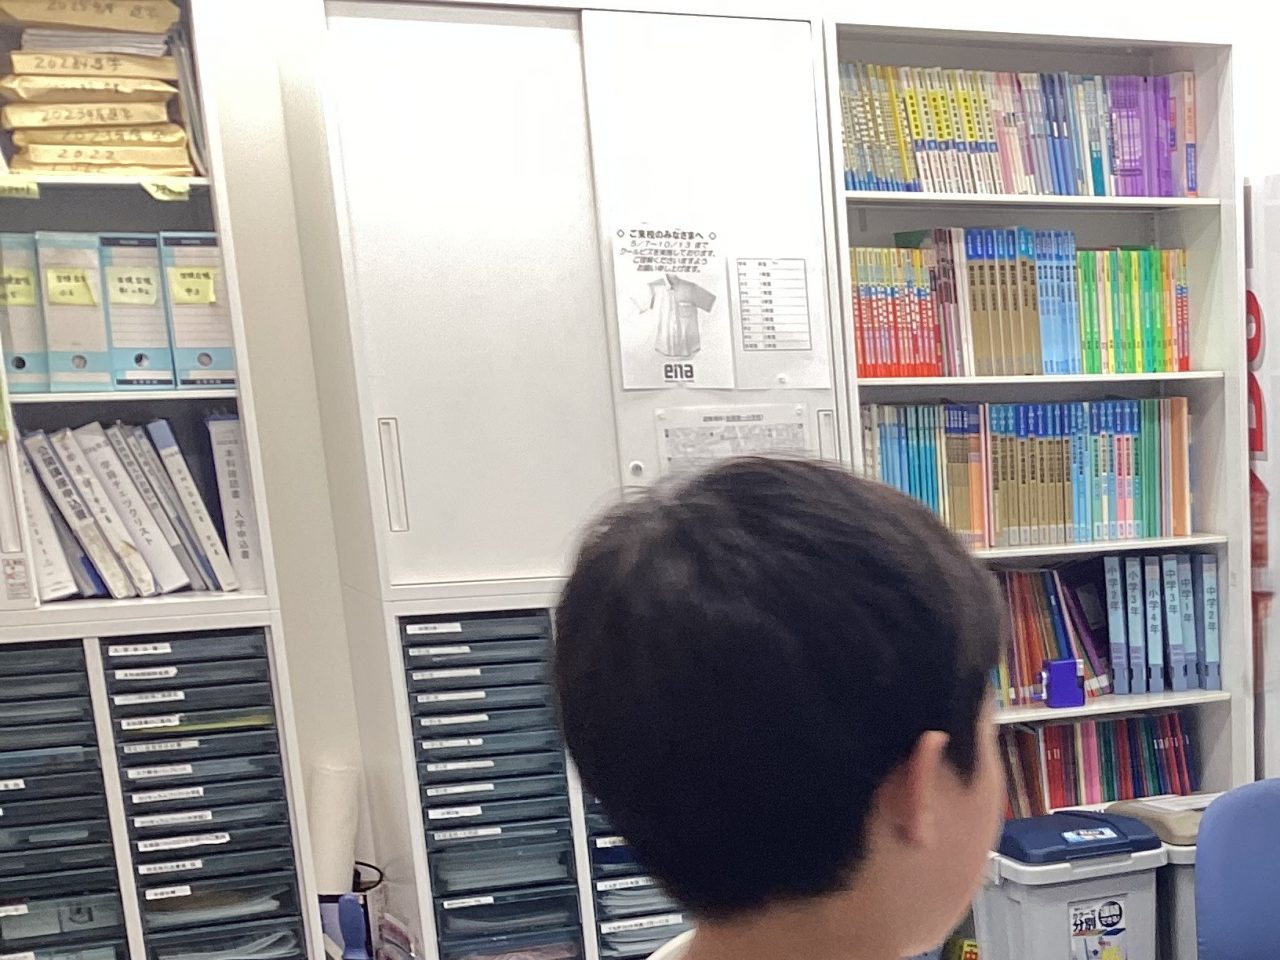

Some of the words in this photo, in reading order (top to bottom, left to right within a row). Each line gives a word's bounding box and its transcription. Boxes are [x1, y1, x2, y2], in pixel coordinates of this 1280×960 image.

[664, 363, 694, 379] ena
[1148, 589, 1159, 632] 小学4年
[1165, 570, 1177, 614] 中学3年
[1181, 579, 1192, 622] 中学1年
[1206, 587, 1216, 631] 中学2年
[1073, 915, 1097, 932] 分別
